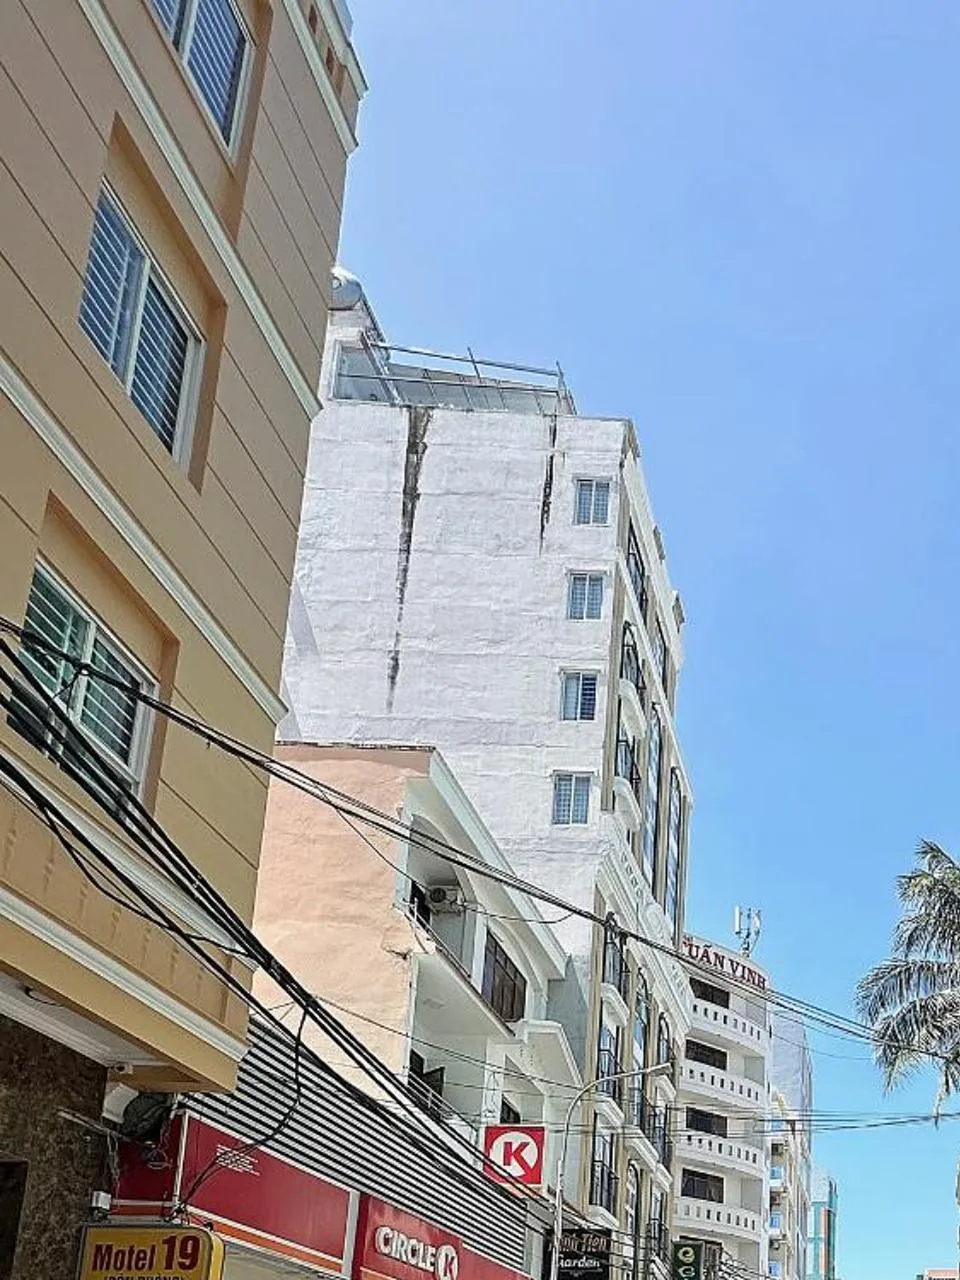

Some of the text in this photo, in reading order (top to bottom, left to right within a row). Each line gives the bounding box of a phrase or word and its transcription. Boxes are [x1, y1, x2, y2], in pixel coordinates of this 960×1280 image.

[499, 1139, 535, 1175] K
[92, 1235, 200, 1271] Motel 19
[375, 1226, 436, 1273] CIRCLE
